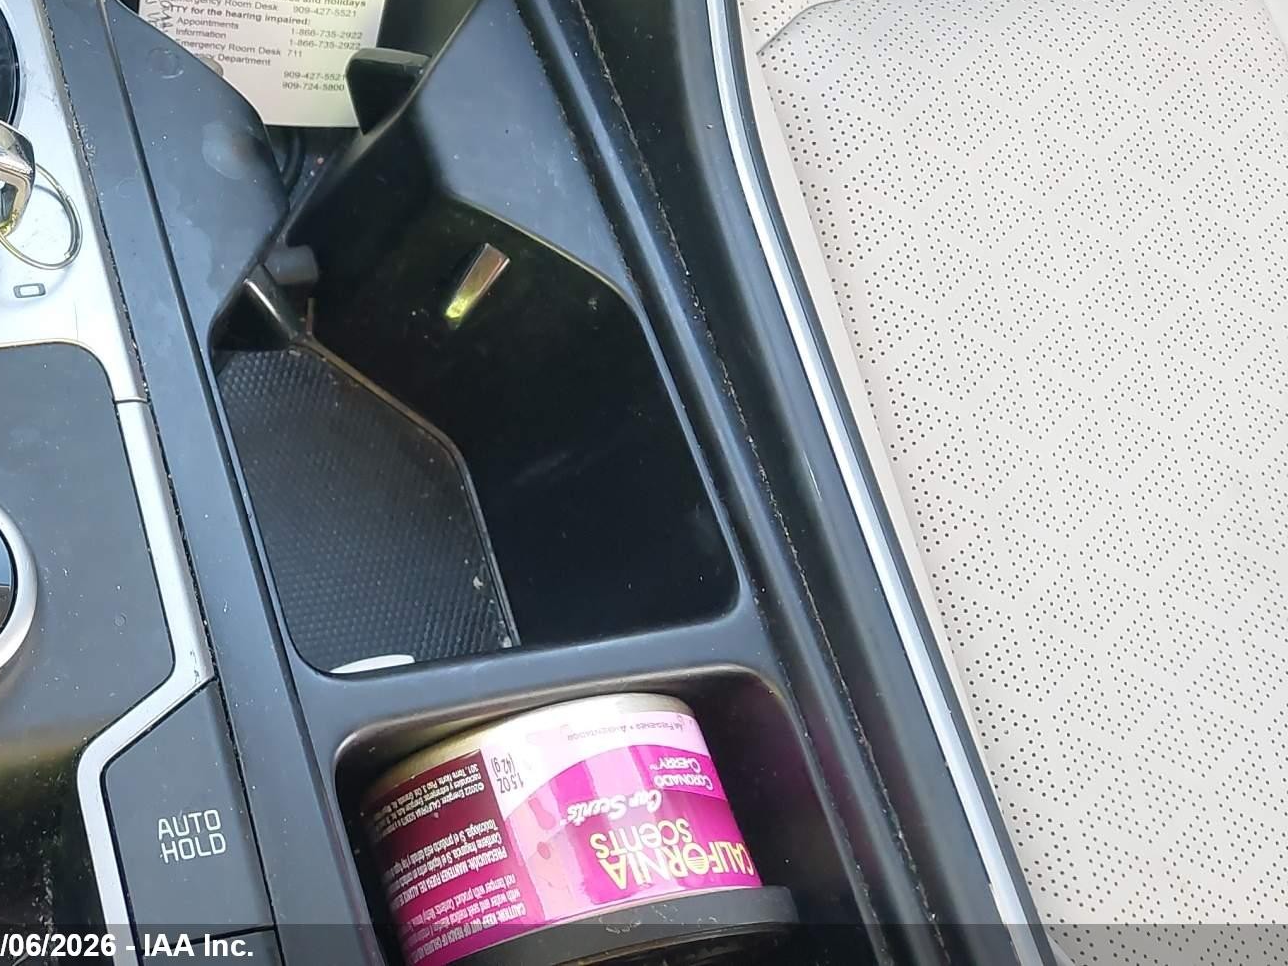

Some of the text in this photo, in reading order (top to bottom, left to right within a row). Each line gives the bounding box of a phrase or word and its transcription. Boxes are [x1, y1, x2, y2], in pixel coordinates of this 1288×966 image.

[224, 0, 252, 8] Room
[254, 2, 279, 11] Desk
[191, 7, 205, 15] for
[207, 8, 223, 16] the
[225, 10, 262, 22] hearing
[177, 17, 239, 30] Appointments
[175, 28, 227, 39] Information
[175, 38, 302, 58] mergency Room Desk 711
[217, 54, 271, 66] Department
[496, 775, 511, 794] OZ
[654, 773, 713, 791] CORONADO
[629, 788, 663, 813] Car
[158, 809, 222, 841] AUTO
[161, 832, 227, 864] HOLD
[598, 841, 756, 891] CALIFORNIA
[490, 893, 507, 908] water
[506, 888, 521, 903] with
[482, 913, 498, 929] KEEP
